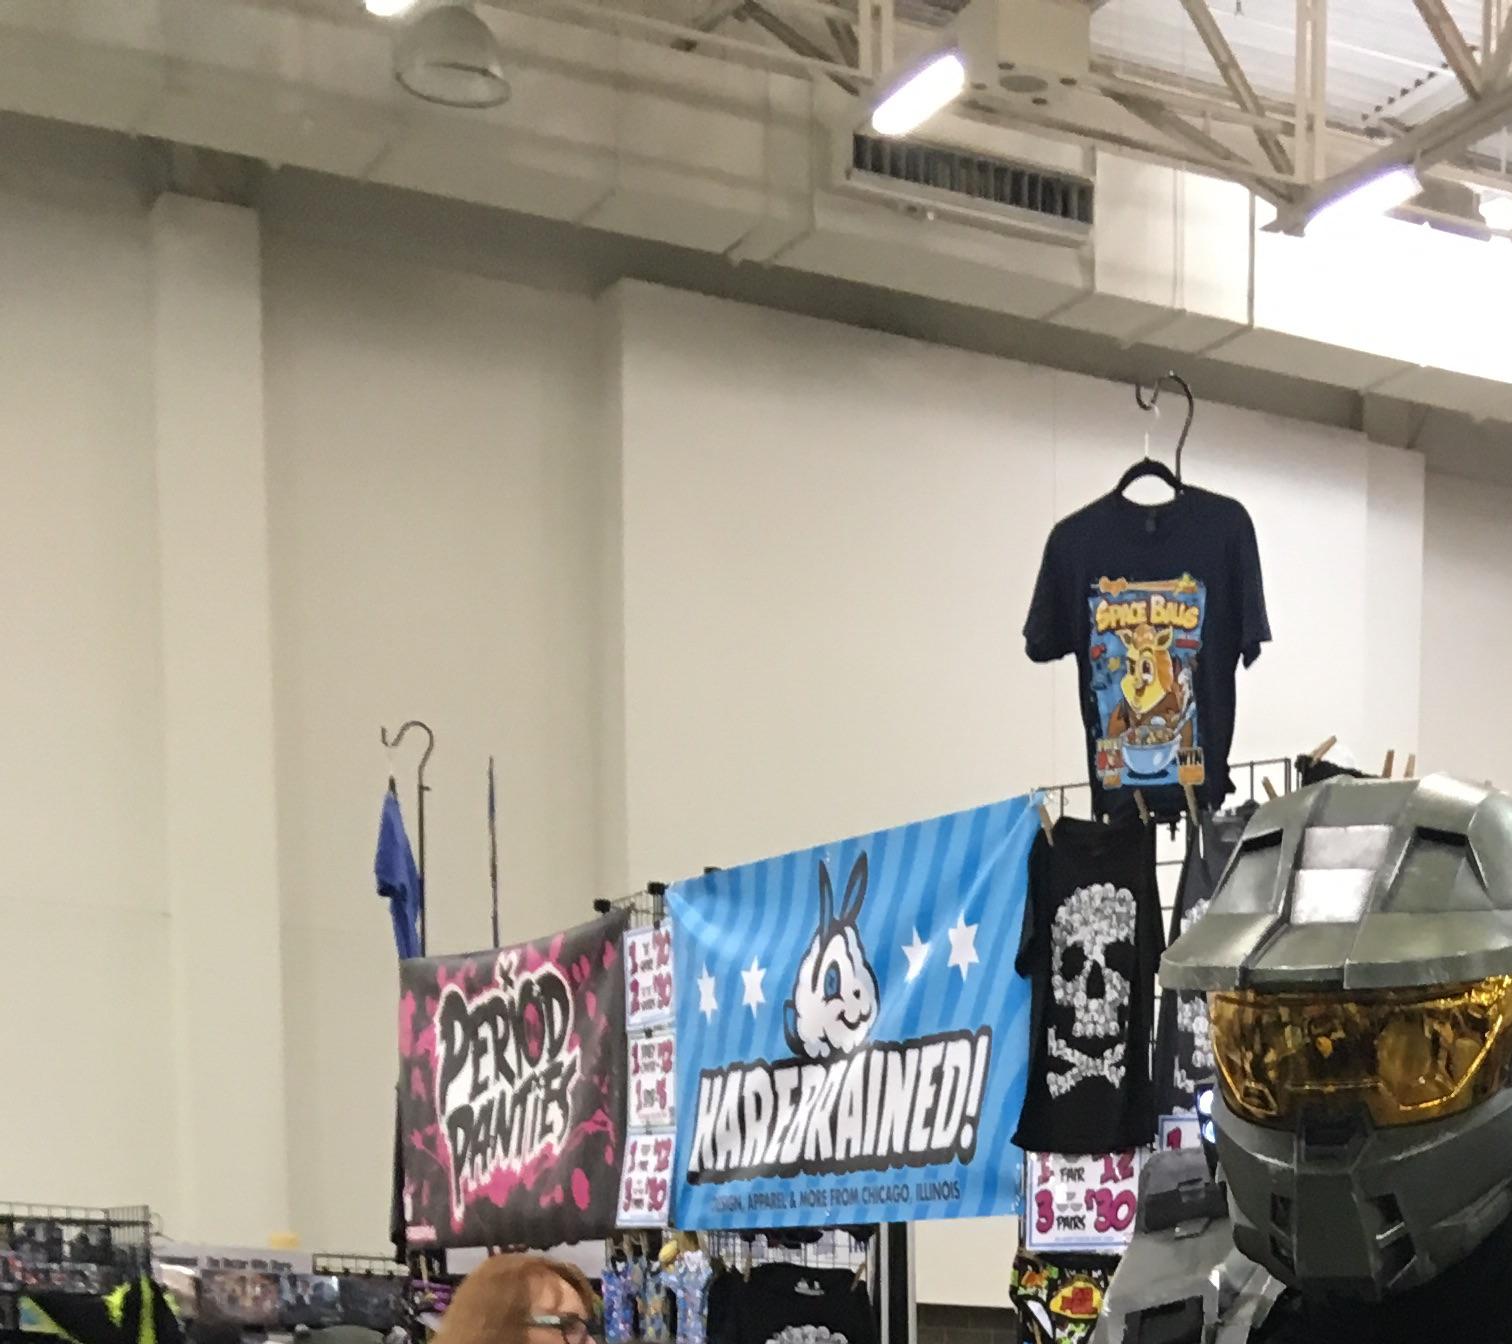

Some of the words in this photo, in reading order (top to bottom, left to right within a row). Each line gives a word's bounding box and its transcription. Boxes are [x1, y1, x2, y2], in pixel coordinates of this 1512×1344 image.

[1096, 599, 1148, 632] SPACE
[1150, 594, 1199, 630] BALLS
[439, 966, 571, 1116] PERIOD
[688, 1034, 989, 1172] HAREBRAINED!
[447, 1052, 579, 1212] PANTIES
[799, 1189, 828, 1209] MORE
[829, 1187, 859, 1207] FROM
[915, 1180, 961, 1201] ILLINOIS
[1035, 1188, 1055, 1234] 3
[1056, 1215, 1087, 1231] PAIRS
